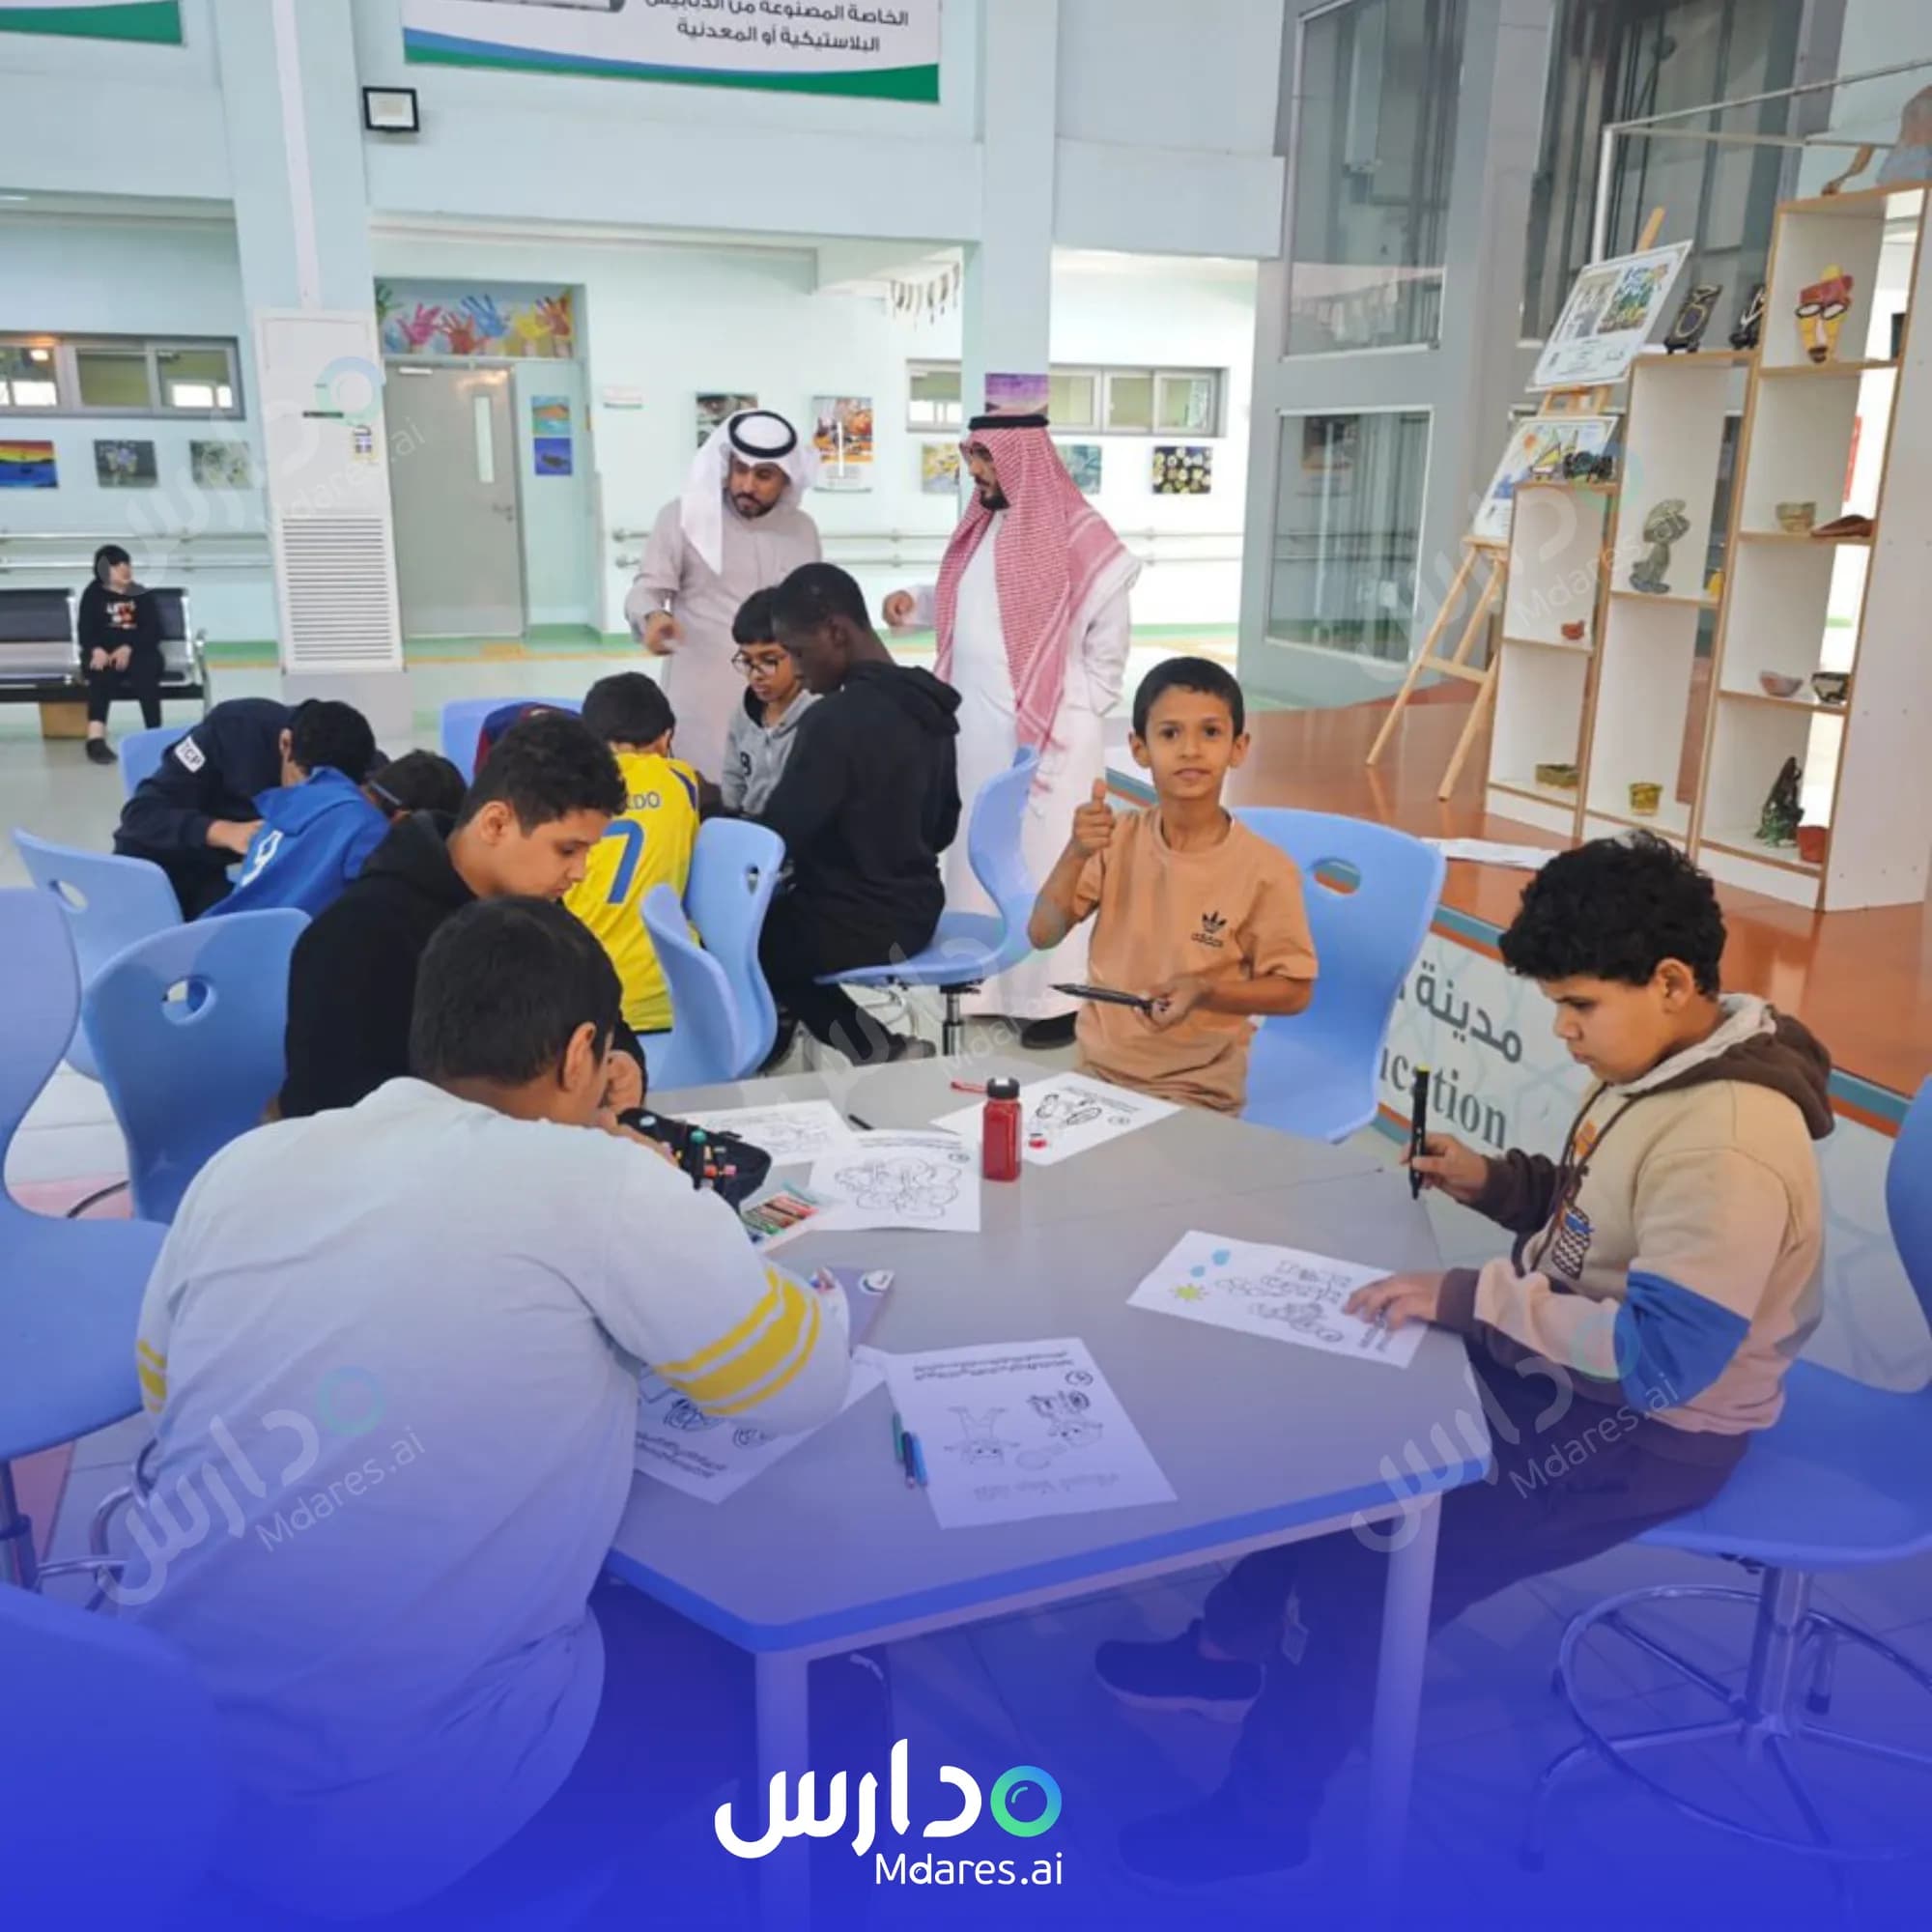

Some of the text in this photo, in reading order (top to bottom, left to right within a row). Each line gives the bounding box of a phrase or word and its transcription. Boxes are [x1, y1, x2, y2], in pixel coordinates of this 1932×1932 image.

[676, 16, 881, 52] البلاستيكية أو المعدنية
[847, 3, 909, 26] الخاصة
[602, 818, 644, 904] 7
[1415, 959, 1522, 1064] مدينة
